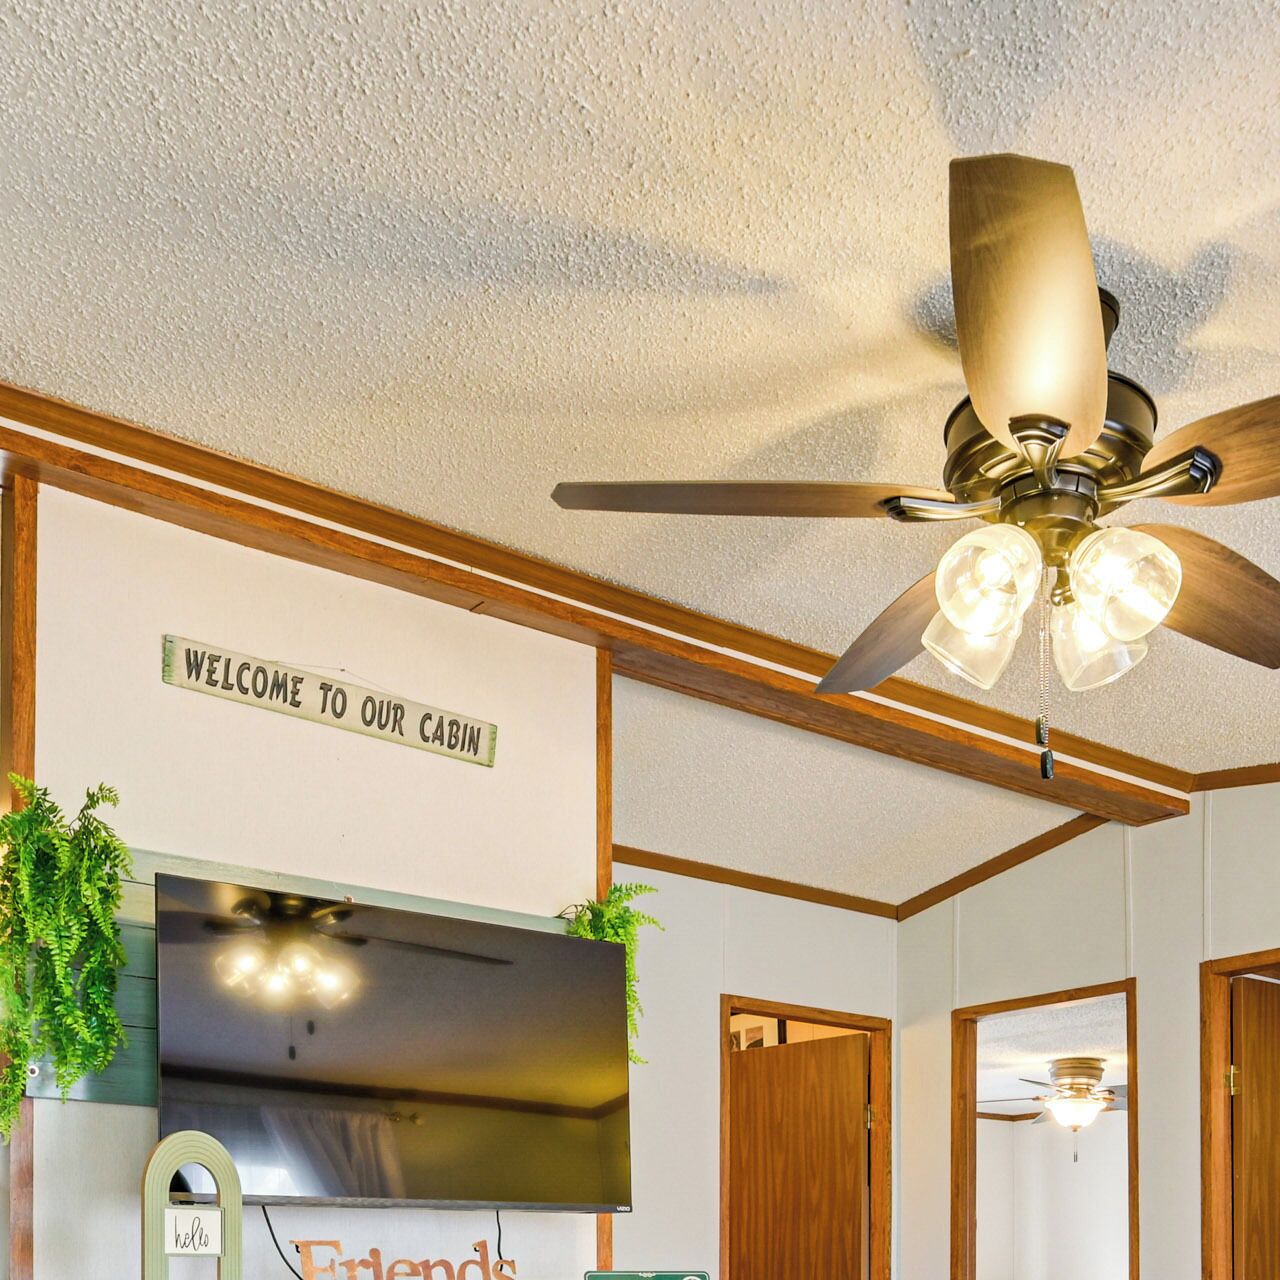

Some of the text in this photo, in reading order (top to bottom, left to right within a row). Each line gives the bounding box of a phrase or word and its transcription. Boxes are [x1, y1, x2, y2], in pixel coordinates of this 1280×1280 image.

[184, 647, 482, 757] WELCOME TO OUR CABIN
[174, 1215, 209, 1251] hello
